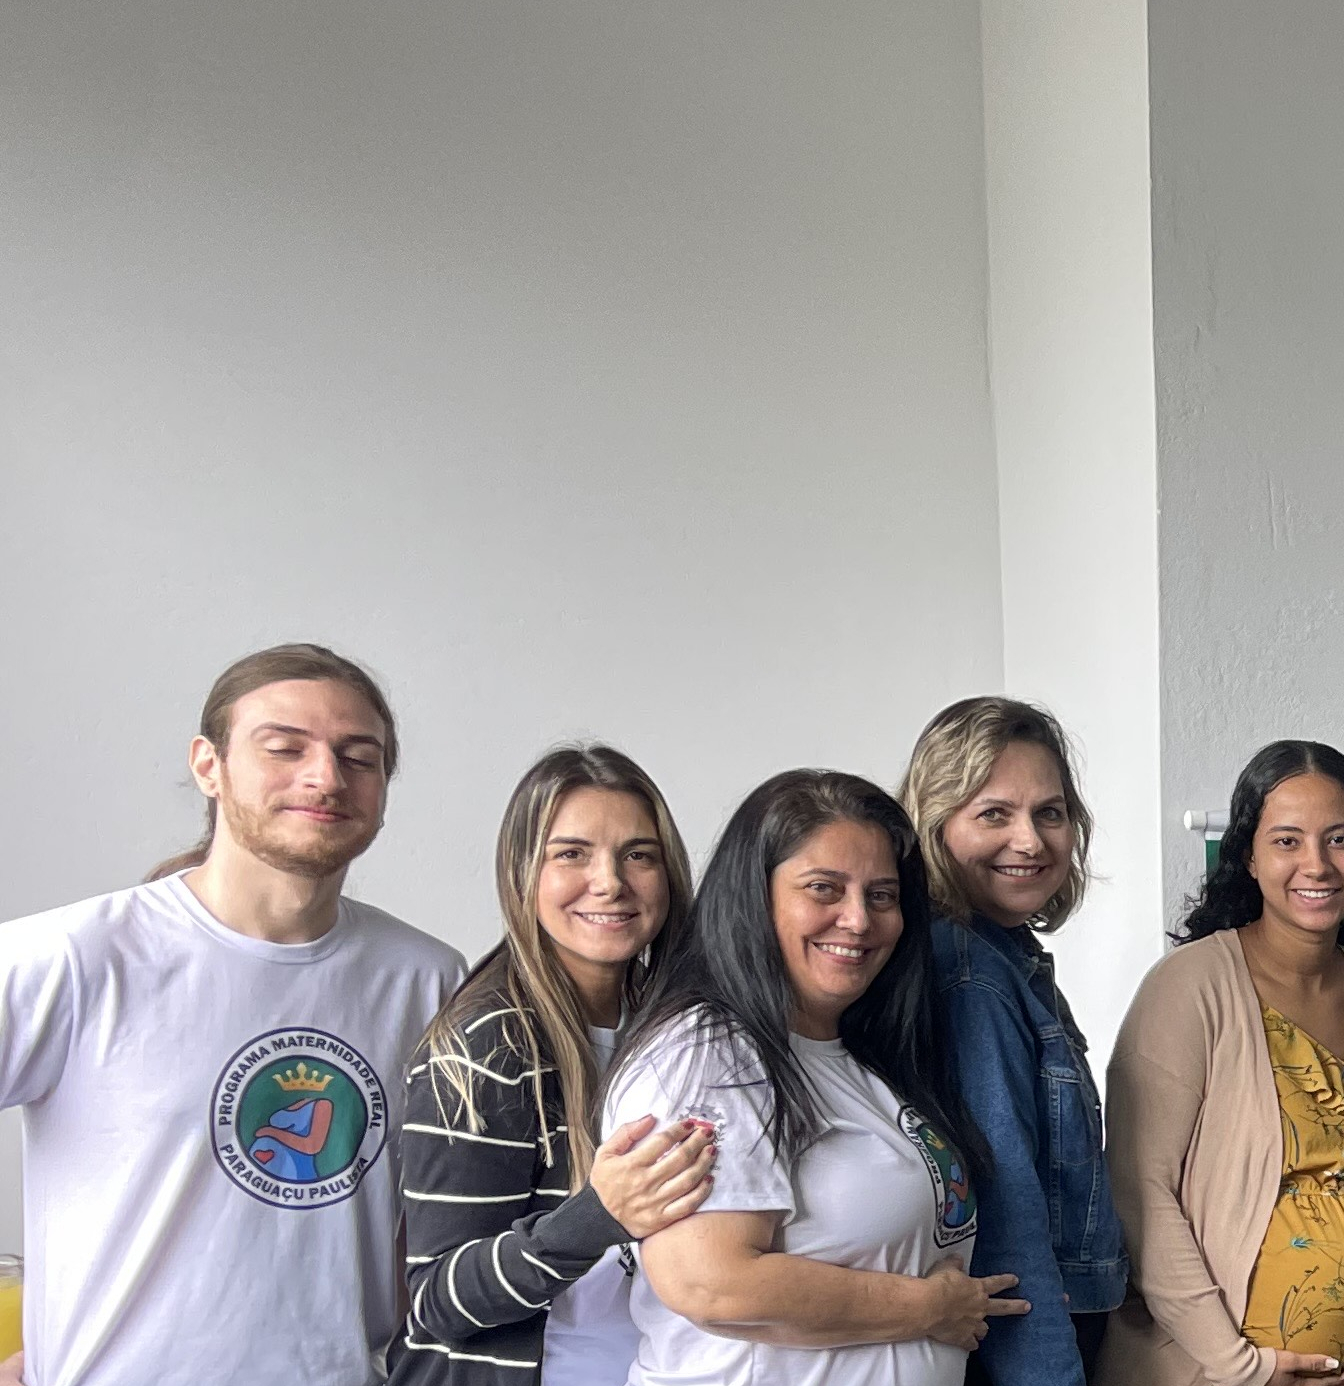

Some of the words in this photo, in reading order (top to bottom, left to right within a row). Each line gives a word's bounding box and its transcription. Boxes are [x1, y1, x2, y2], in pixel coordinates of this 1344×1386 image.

[218, 1046, 271, 1126] PROGRAMA
[270, 1035, 376, 1089] MATERNIDADE
[368, 1090, 383, 1130] REAL
[220, 1143, 304, 1202] PARAGUAÇU
[309, 1157, 369, 1200] PAULISTA
